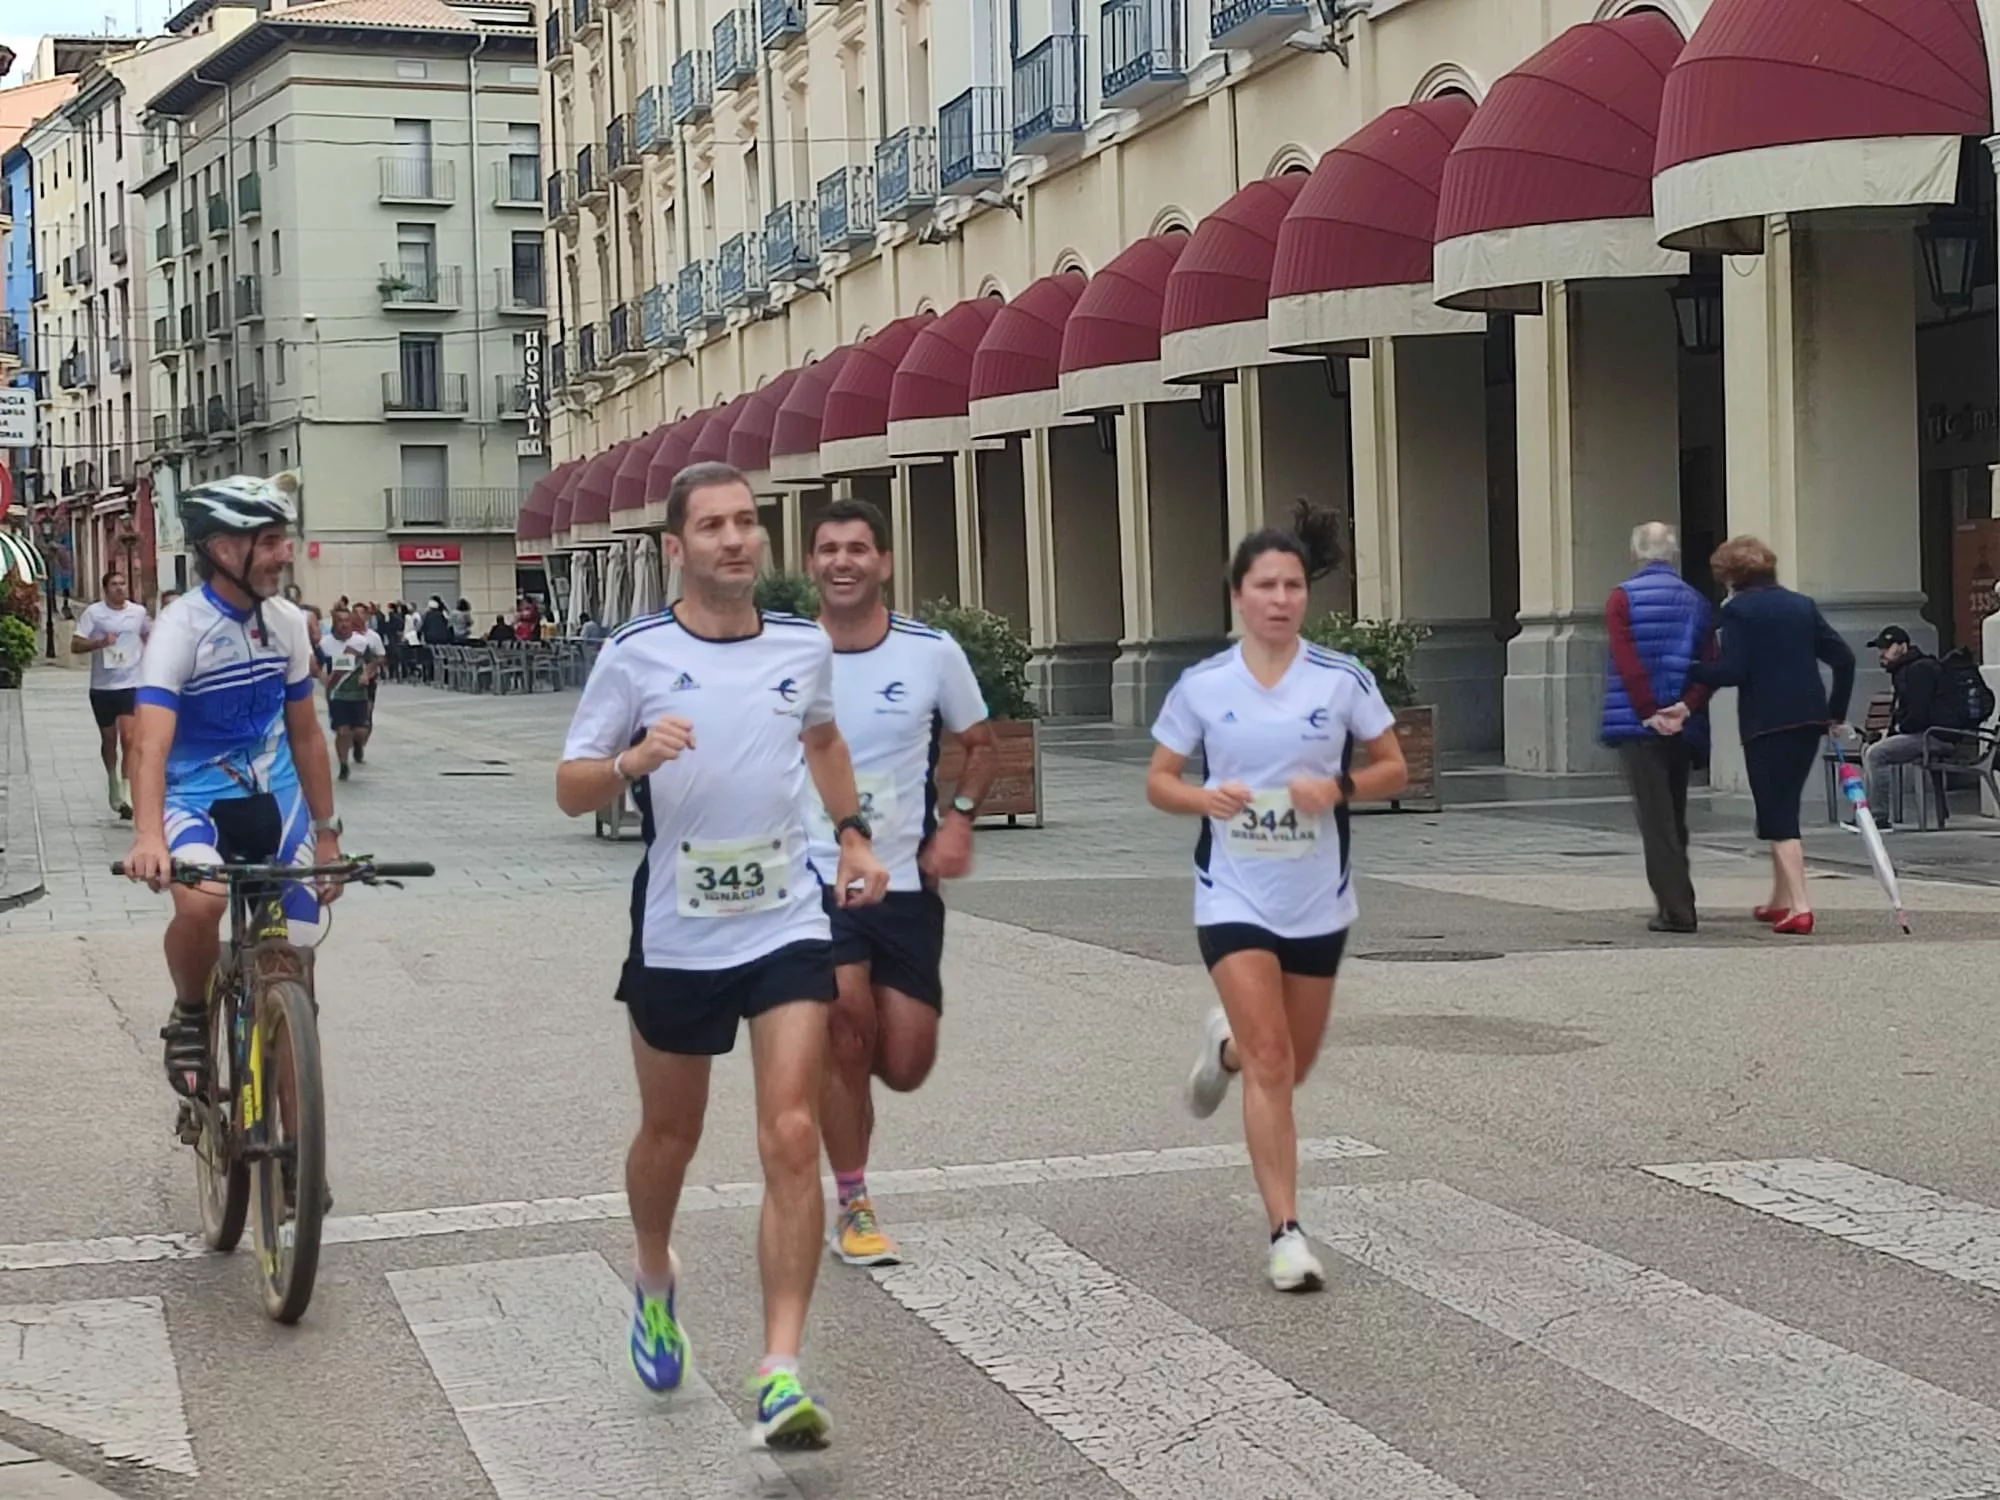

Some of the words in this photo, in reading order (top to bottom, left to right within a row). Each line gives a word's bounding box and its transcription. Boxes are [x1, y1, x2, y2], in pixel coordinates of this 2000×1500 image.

[524, 330, 541, 436] HOSTAL
[415, 548, 445, 560] GAES
[1241, 806, 1298, 831] 344
[695, 862, 764, 891] 343
